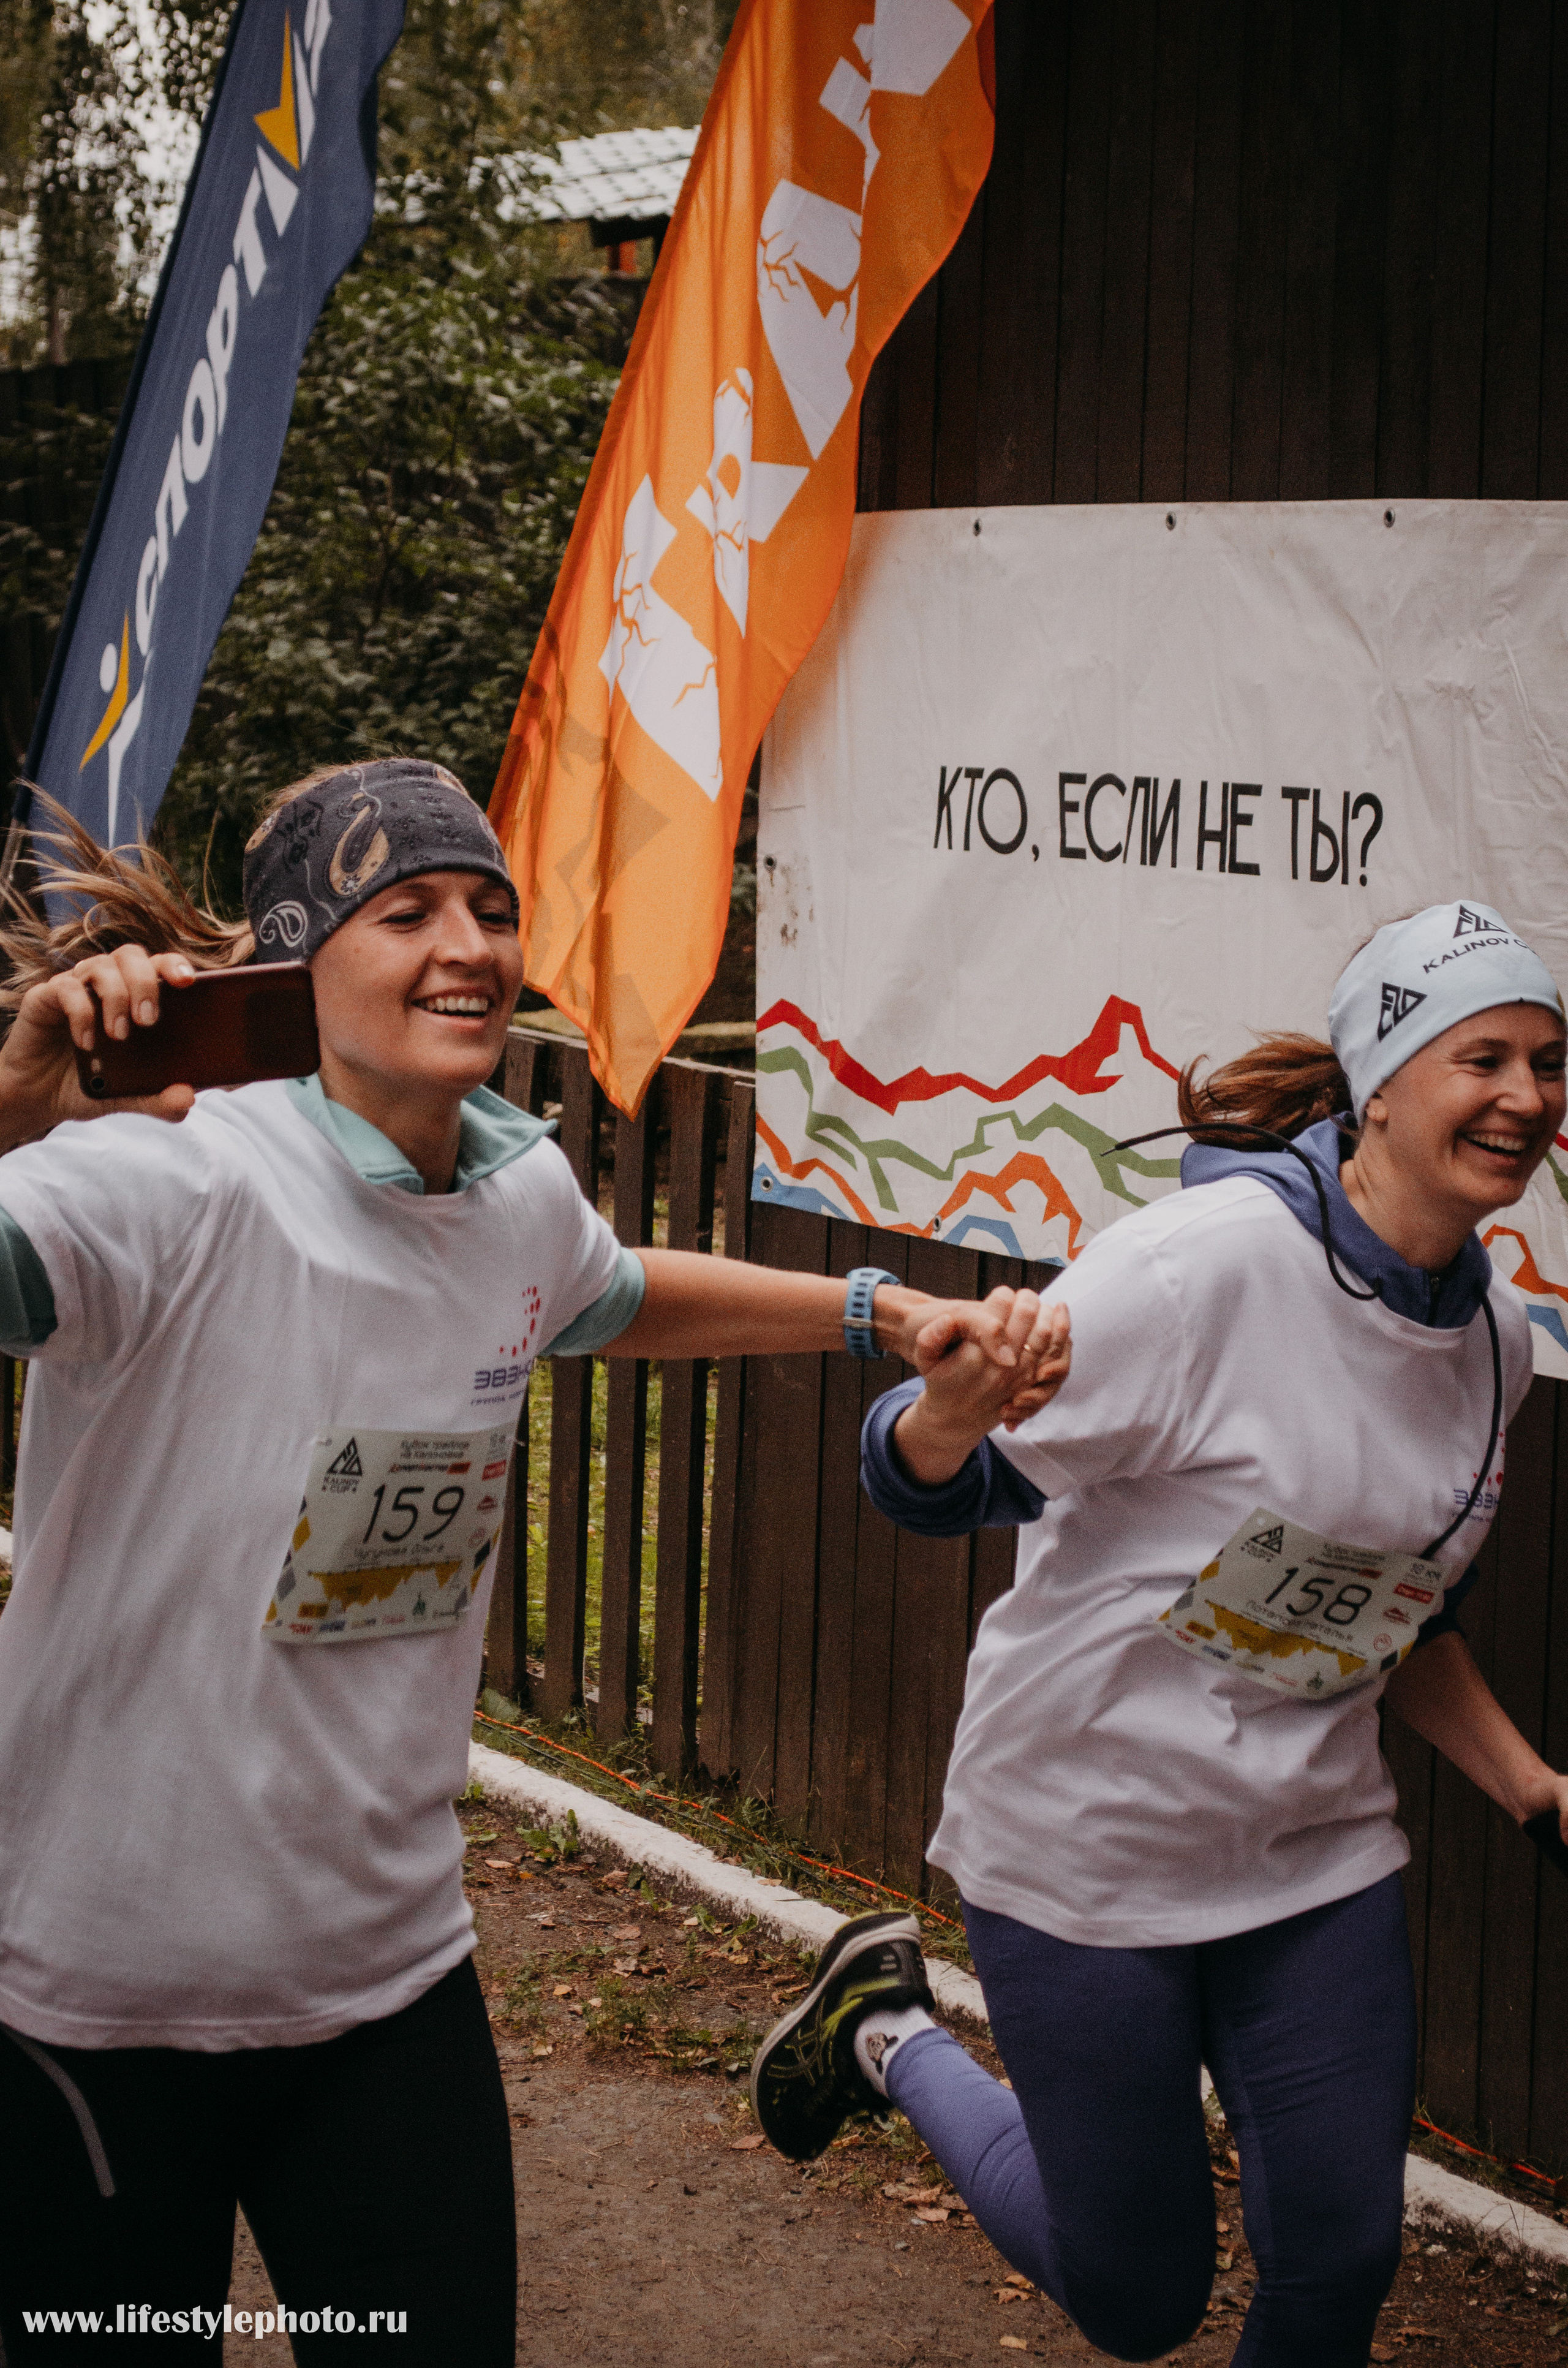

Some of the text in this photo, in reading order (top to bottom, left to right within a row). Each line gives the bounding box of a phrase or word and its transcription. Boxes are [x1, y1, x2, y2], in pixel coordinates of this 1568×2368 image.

[933, 765, 1384, 887] КТО, ЕСЛИ НЕ ТЫ?
[1422, 937, 1510, 974] KALINOV
[363, 1484, 465, 1544] 159
[1265, 1567, 1373, 1625] 158
